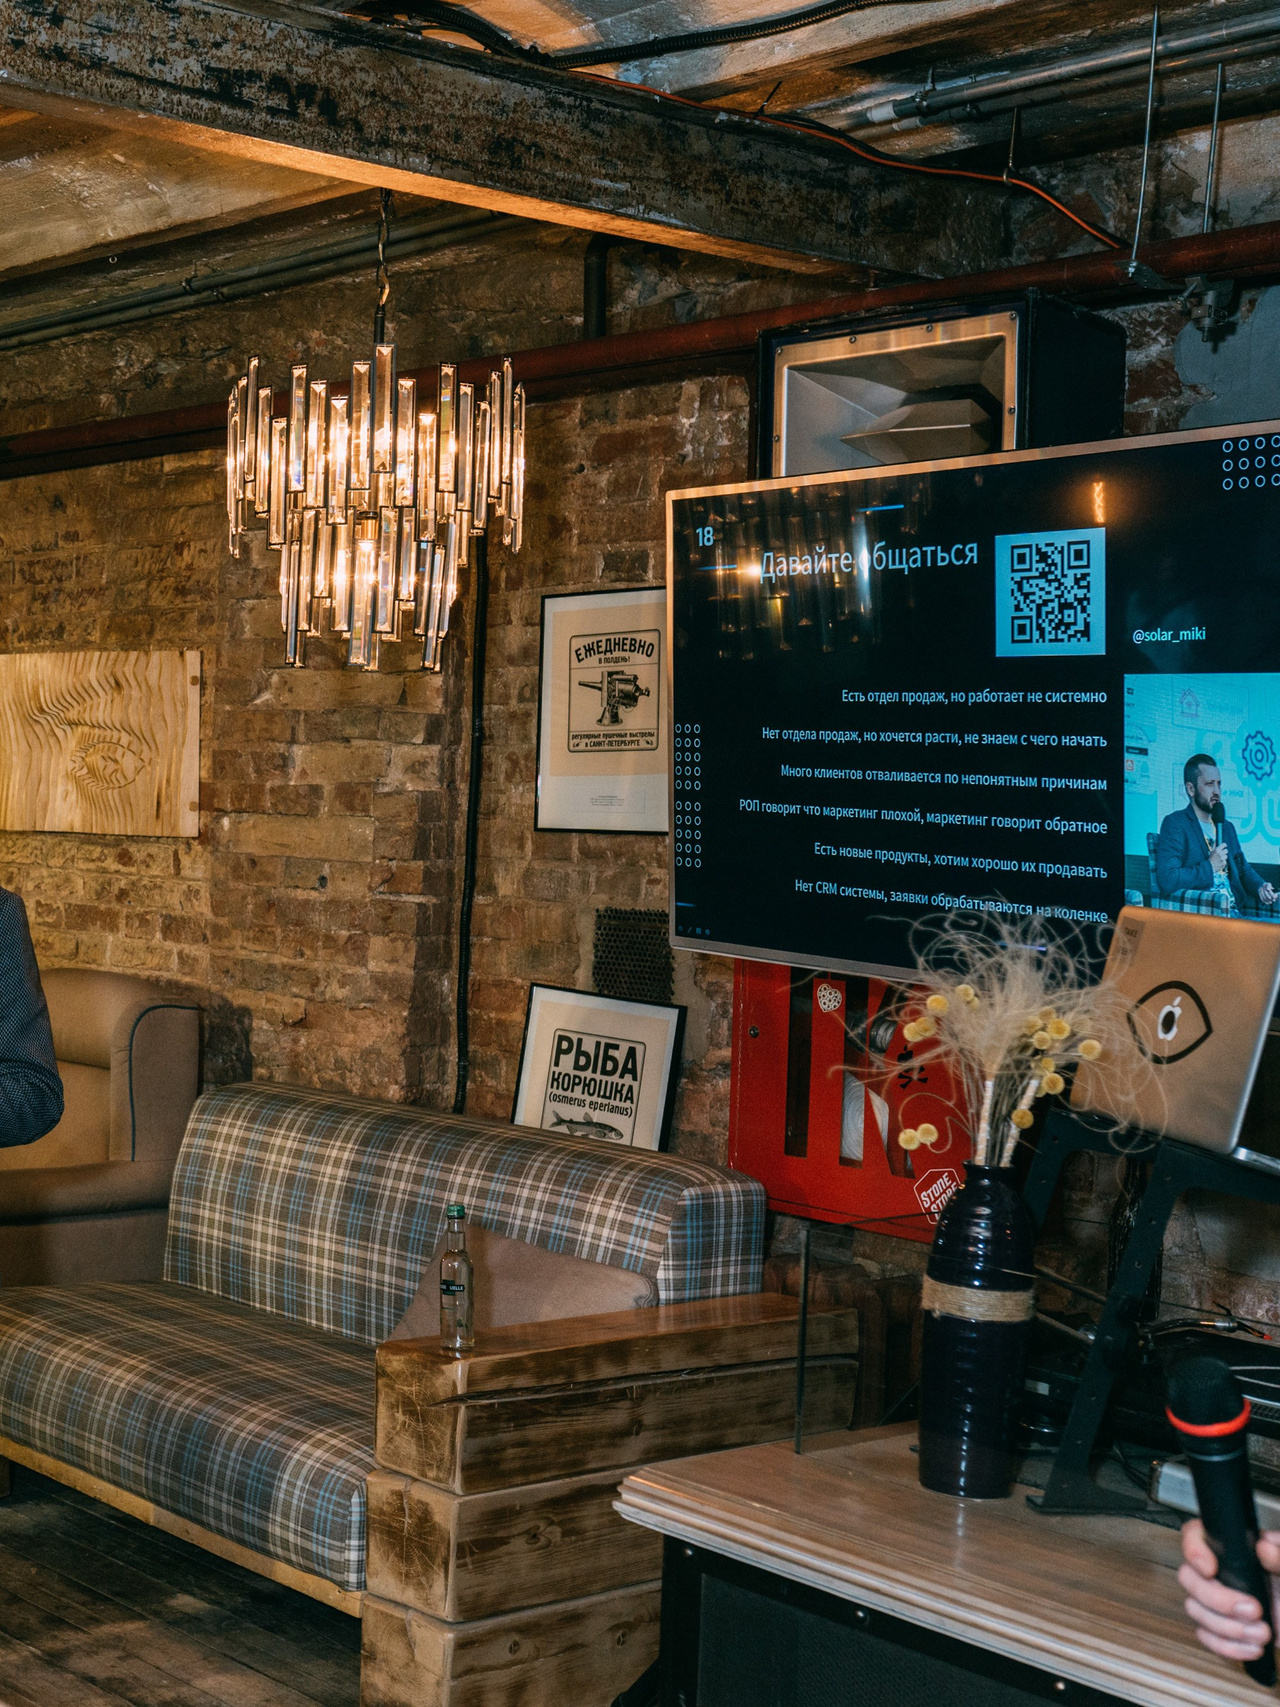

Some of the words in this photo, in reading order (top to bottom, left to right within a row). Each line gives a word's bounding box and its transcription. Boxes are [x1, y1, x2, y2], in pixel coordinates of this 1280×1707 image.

[696, 526, 715, 547] 18
[760, 545, 853, 584] Давайте
[865, 540, 979, 575] общаться
[1132, 626, 1207, 645] @solar_miki
[574, 637, 655, 663] ЕЖЕДНЕВНО
[603, 655, 631, 665] ПОЛДЕНЬ!
[841, 689, 866, 702] Есть
[867, 691, 899, 705] отдел
[901, 691, 948, 706] продаж,
[950, 691, 966, 703] но
[967, 687, 1025, 706] работает
[1026, 691, 1043, 703] не
[1044, 691, 1107, 703] системно
[589, 739, 641, 748] САНКТ-ПЕТЕРБУРГЕ
[761, 726, 780, 739] Нет
[781, 729, 817, 742] отдела
[818, 730, 861, 744] продаж,
[863, 731, 877, 742] но
[879, 731, 923, 743] хочется
[924, 732, 962, 746] расти,
[963, 733, 979, 744] не
[980, 733, 1018, 745] знаем
[1019, 734, 1028, 745] с
[1029, 734, 1058, 746] чего
[1061, 735, 1107, 747] начать
[780, 764, 813, 779] Много
[813, 768, 863, 780] клиентов
[865, 769, 941, 783] отваливается
[943, 773, 959, 784] по
[961, 773, 1037, 788] непонятным
[1040, 776, 1107, 792] причинам
[739, 798, 760, 812] РОП
[761, 802, 801, 817] говорит
[802, 804, 821, 816] что
[822, 806, 879, 820] маркетинг
[880, 807, 924, 825] плохой,
[925, 812, 989, 827] маркетинг
[990, 816, 1042, 832] говорит
[1043, 817, 1108, 835] обратное
[814, 841, 837, 856] Есть
[839, 846, 873, 859] новые
[874, 849, 931, 866] продукты,
[933, 854, 969, 867] хотим
[971, 856, 1019, 872] хорошо
[1020, 861, 1036, 873] их
[1037, 862, 1108, 879] продавать
[795, 878, 813, 892] Нет
[815, 880, 837, 895] CRM
[839, 885, 888, 903] системы,
[889, 890, 929, 904] заявки
[930, 892, 1033, 916] обрабатываются
[1035, 904, 1052, 918] на
[1053, 906, 1108, 923] коленке
[553, 1034, 639, 1081] РЫБА
[549, 1070, 635, 1105] КОРЮШКА
[548, 1091, 587, 1108] (osmerus
[588, 1100, 634, 1118] eperlanus)
[920, 1172, 952, 1208] STONE
